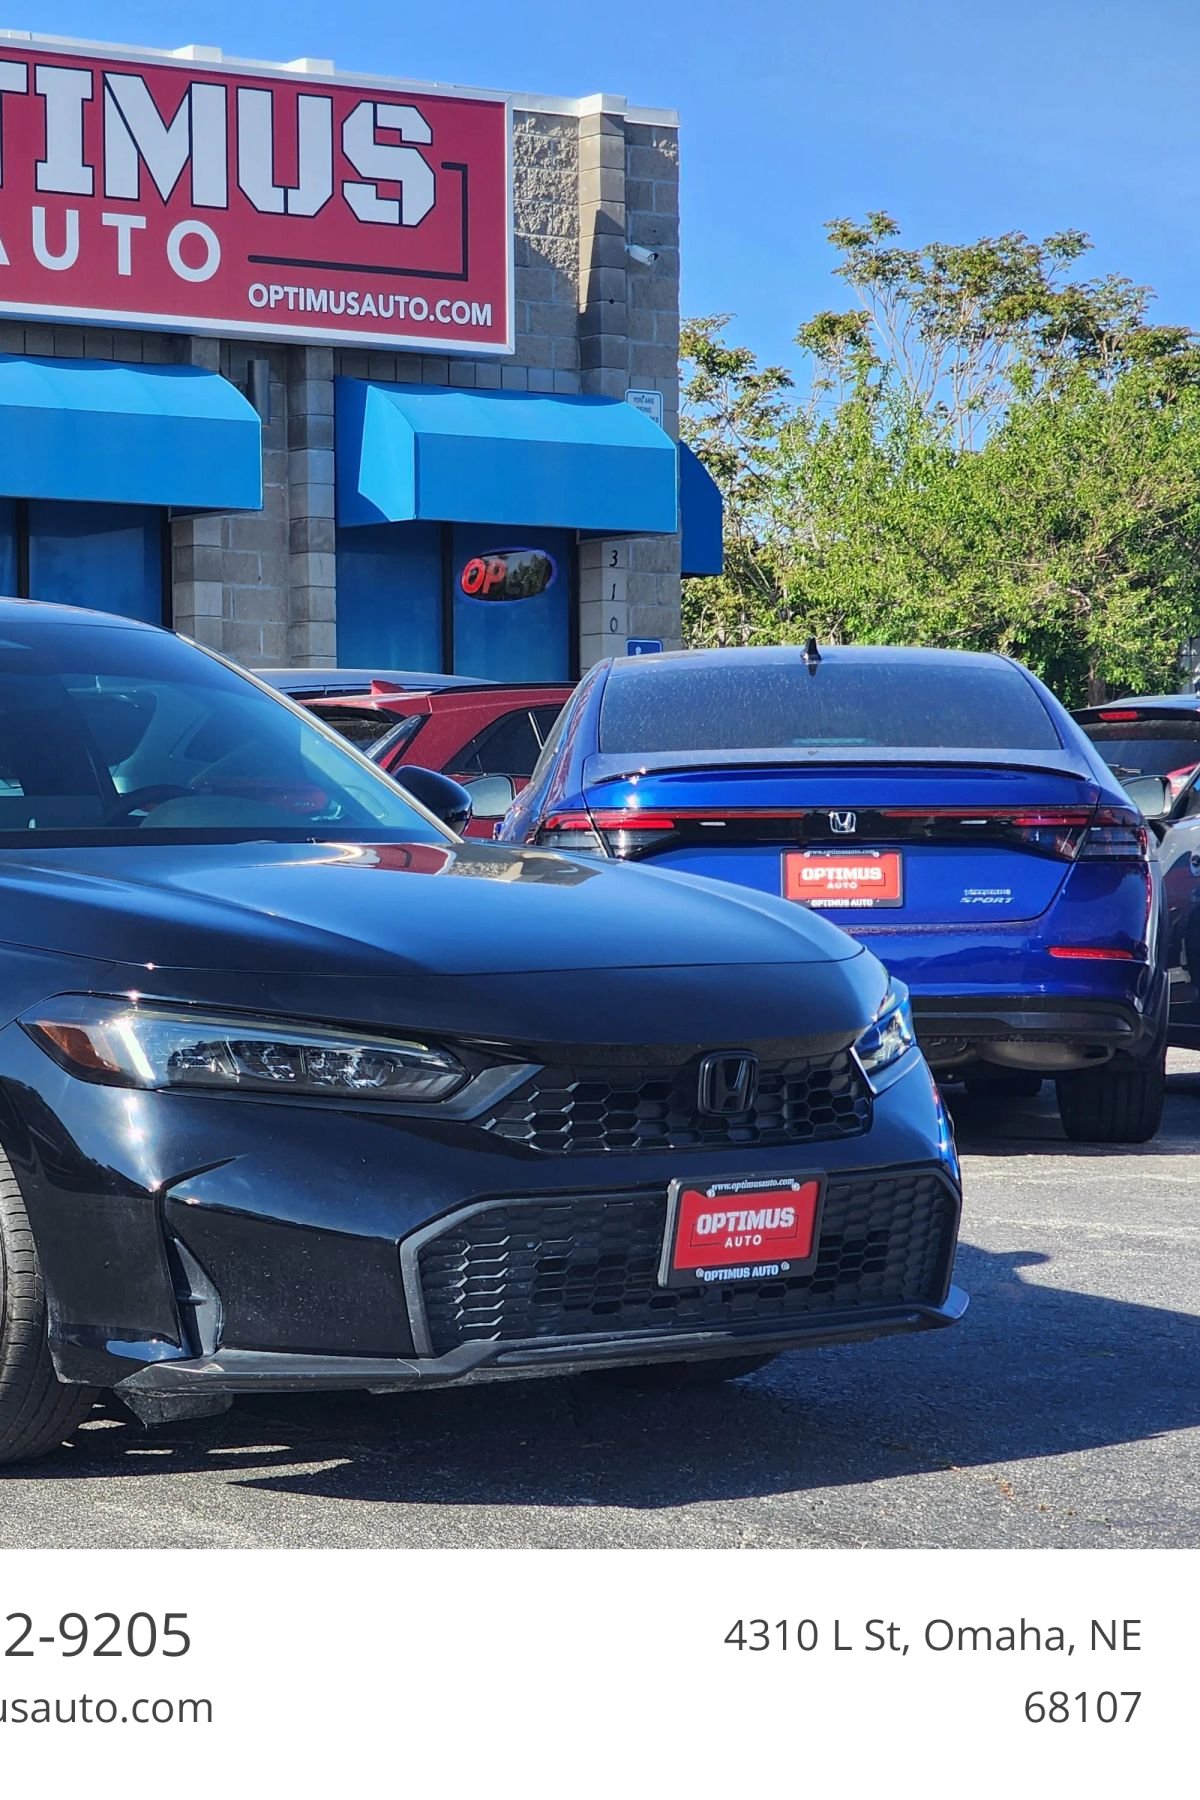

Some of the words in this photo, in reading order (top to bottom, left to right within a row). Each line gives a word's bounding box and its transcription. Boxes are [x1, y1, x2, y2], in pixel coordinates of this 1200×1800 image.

[247, 282, 493, 328] OPTIMUSAUTO.COM
[801, 867, 883, 881] OPTIMUS
[827, 882, 858, 890] AUTO
[810, 898, 850, 908] OPTIMUS
[850, 898, 874, 908] AUTO
[960, 896, 1015, 904] SPORT
[711, 1178, 795, 1193] www.optimusauto.com
[696, 1207, 795, 1236] OPTIMUS
[724, 1234, 763, 1249] AUTO
[703, 1266, 751, 1283] OPTIMUS
[752, 1264, 779, 1278] AUTO
